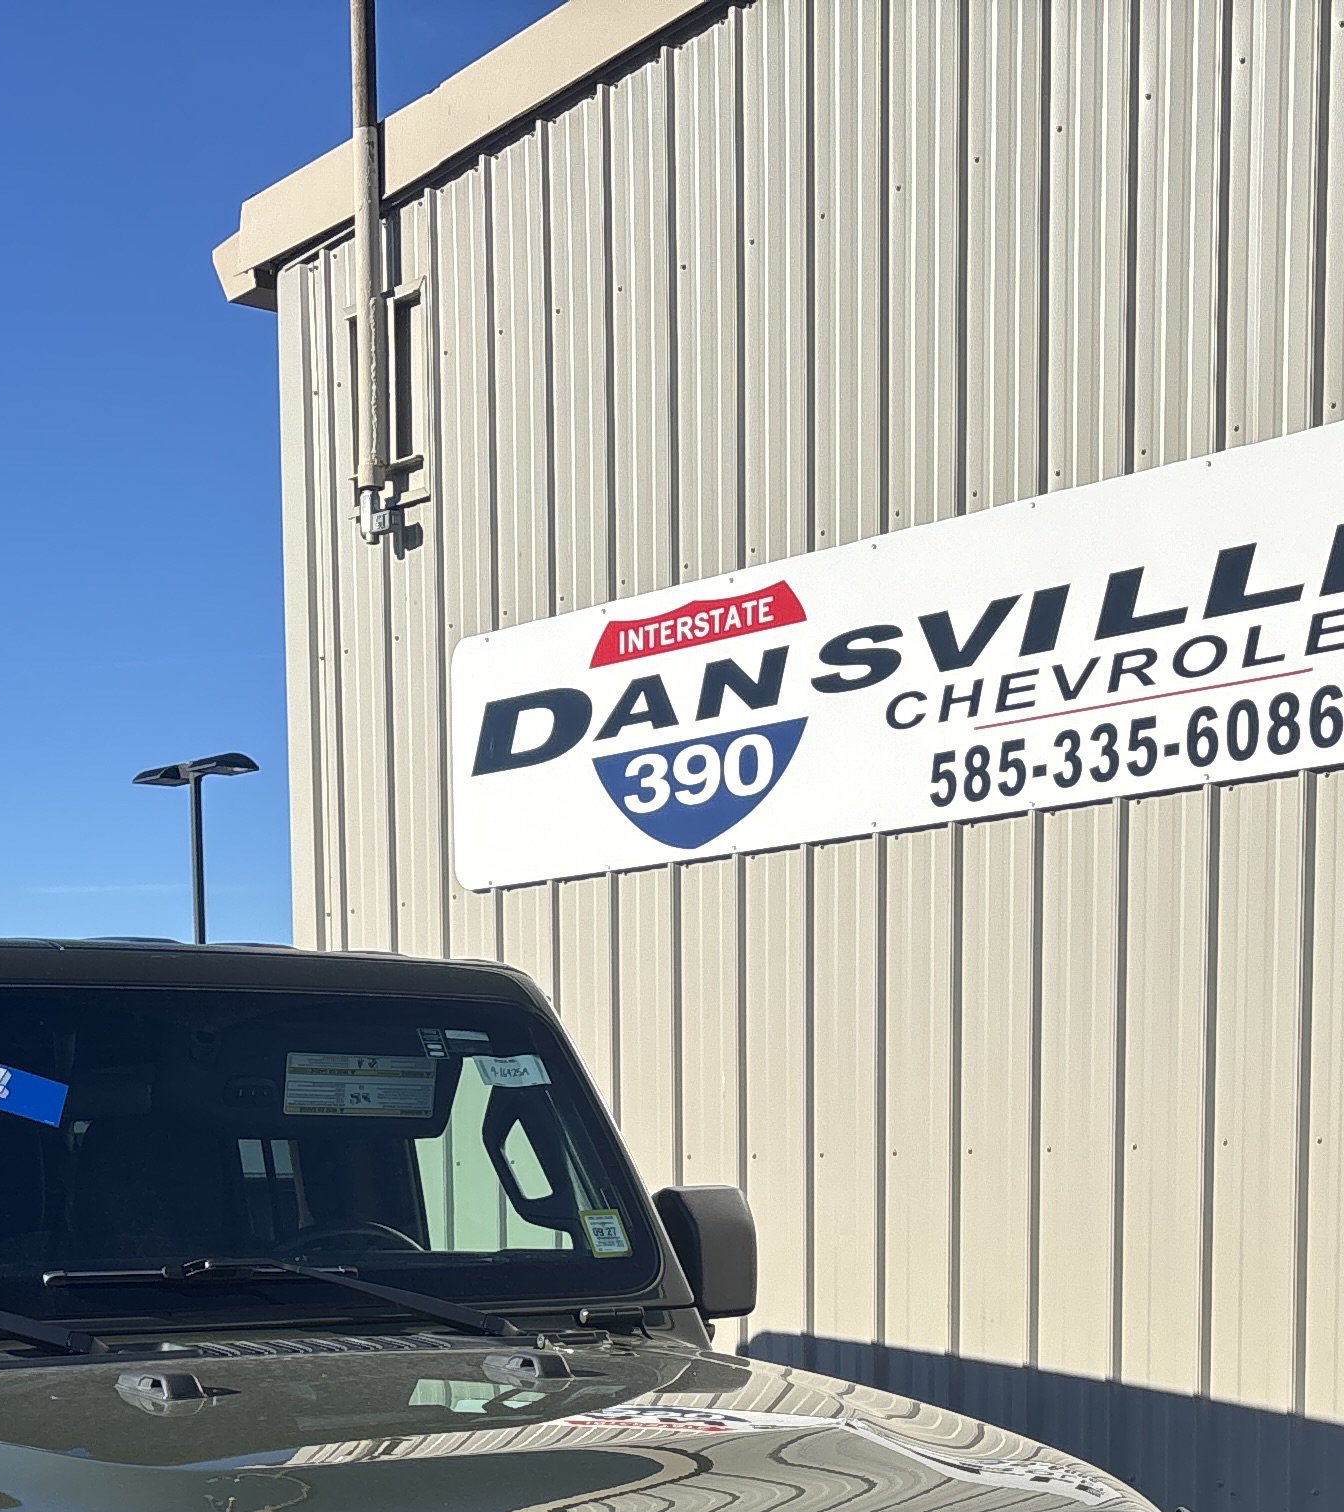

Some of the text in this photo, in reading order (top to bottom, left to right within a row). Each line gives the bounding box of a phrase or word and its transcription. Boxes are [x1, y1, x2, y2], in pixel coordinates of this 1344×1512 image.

[618, 595, 775, 655] INTERSTATE
[623, 733, 775, 815] 390
[928, 684, 1344, 808] 585-335-6086
